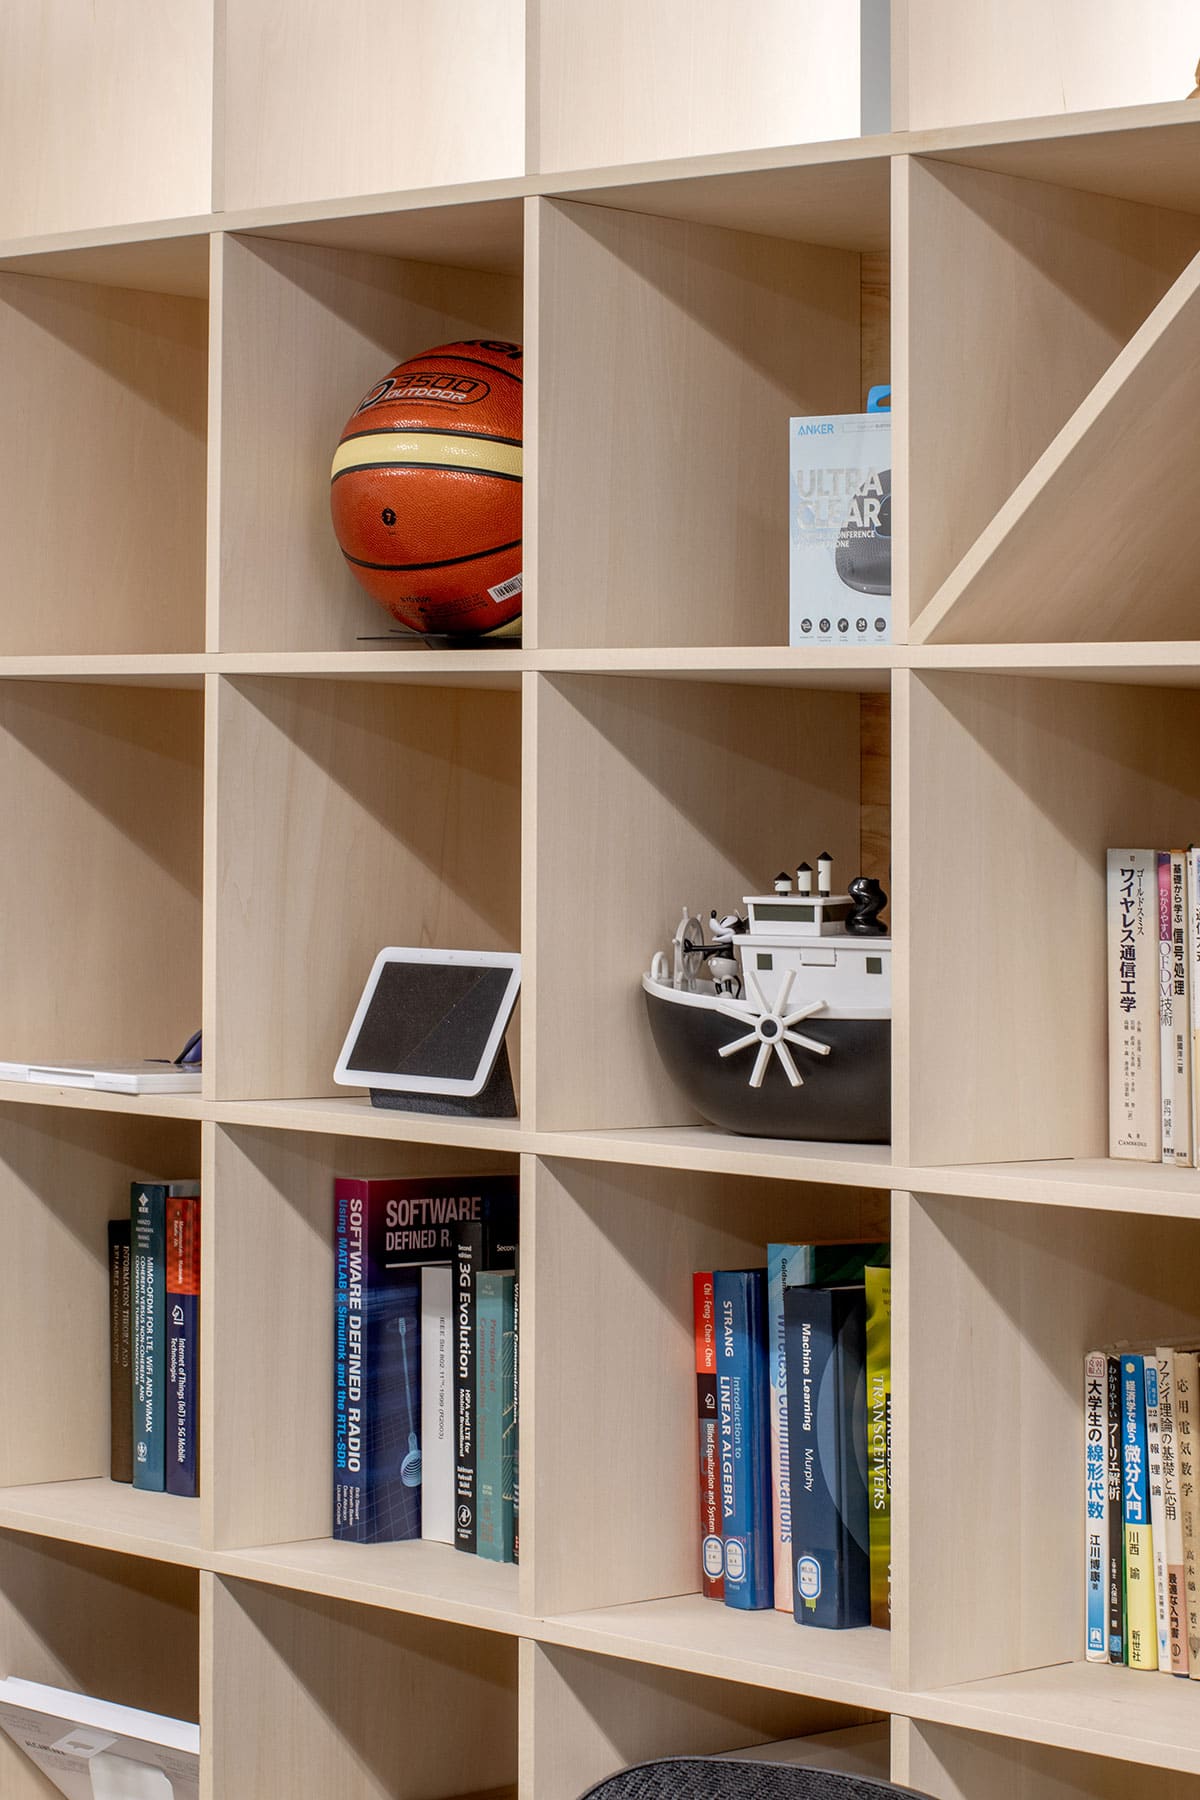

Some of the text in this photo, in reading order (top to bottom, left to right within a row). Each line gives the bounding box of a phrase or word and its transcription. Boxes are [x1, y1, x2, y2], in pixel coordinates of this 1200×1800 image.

[385, 387, 467, 402] OUTDOOR
[395, 375, 480, 394] 3500
[798, 424, 834, 435] ANKER
[797, 466, 884, 497] ULTRA
[797, 497, 881, 529] CLEAR
[1136, 868, 1144, 935] ゴールドスミス
[1120, 868, 1137, 1013] ワイヤレス通信工学
[1173, 864, 1185, 996] 基礎から学ぶ 信号処理
[1159, 888, 1173, 1027] わかりやすい OFDM技術
[386, 1197, 482, 1228] SOFTWARE
[385, 1229, 436, 1251] DEFINED
[122, 1245, 130, 1307] INFORMATION
[146, 1256, 154, 1315] MIMO-OFDM
[145, 1336, 154, 1353] LTE,
[146, 1315, 154, 1334] FOR
[336, 1199, 348, 1468] Using MATLAB & Simulink and the RTL-SDR
[348, 1199, 362, 1473] SOFTWARE DEFINED RADIO
[459, 1262, 472, 1378] 3G Evolution
[704, 1323, 713, 1343] Chen
[723, 1300, 734, 1358] STRANG
[170, 1337, 178, 1383] Technologies
[178, 1337, 186, 1367] Internet
[178, 1367, 186, 1376] of
[705, 1347, 713, 1367] Chen
[176, 1376, 186, 1400] Things
[801, 1323, 814, 1431] Machine Learning
[1108, 1365, 1118, 1418] わかりやすい
[178, 1418, 186, 1426] in
[733, 1376, 742, 1459] Introduction to
[178, 1437, 186, 1463] Mobile
[720, 1376, 733, 1518] LINEAR ALGEBRA
[872, 1376, 885, 1510] TRANSCEIVERS
[1087, 1379, 1104, 1519] 大学生の線形代数
[1108, 1423, 1121, 1501] フーリエ解析
[1125, 1380, 1142, 1519] 経済学で使う 微分入門
[1149, 1422, 1162, 1497] 情報理論
[706, 1423, 716, 1533] Blind Equalization and System
[803, 1448, 814, 1492] Murphy
[1129, 1531, 1140, 1556] 川西
[1132, 1630, 1142, 1662] 新世社
